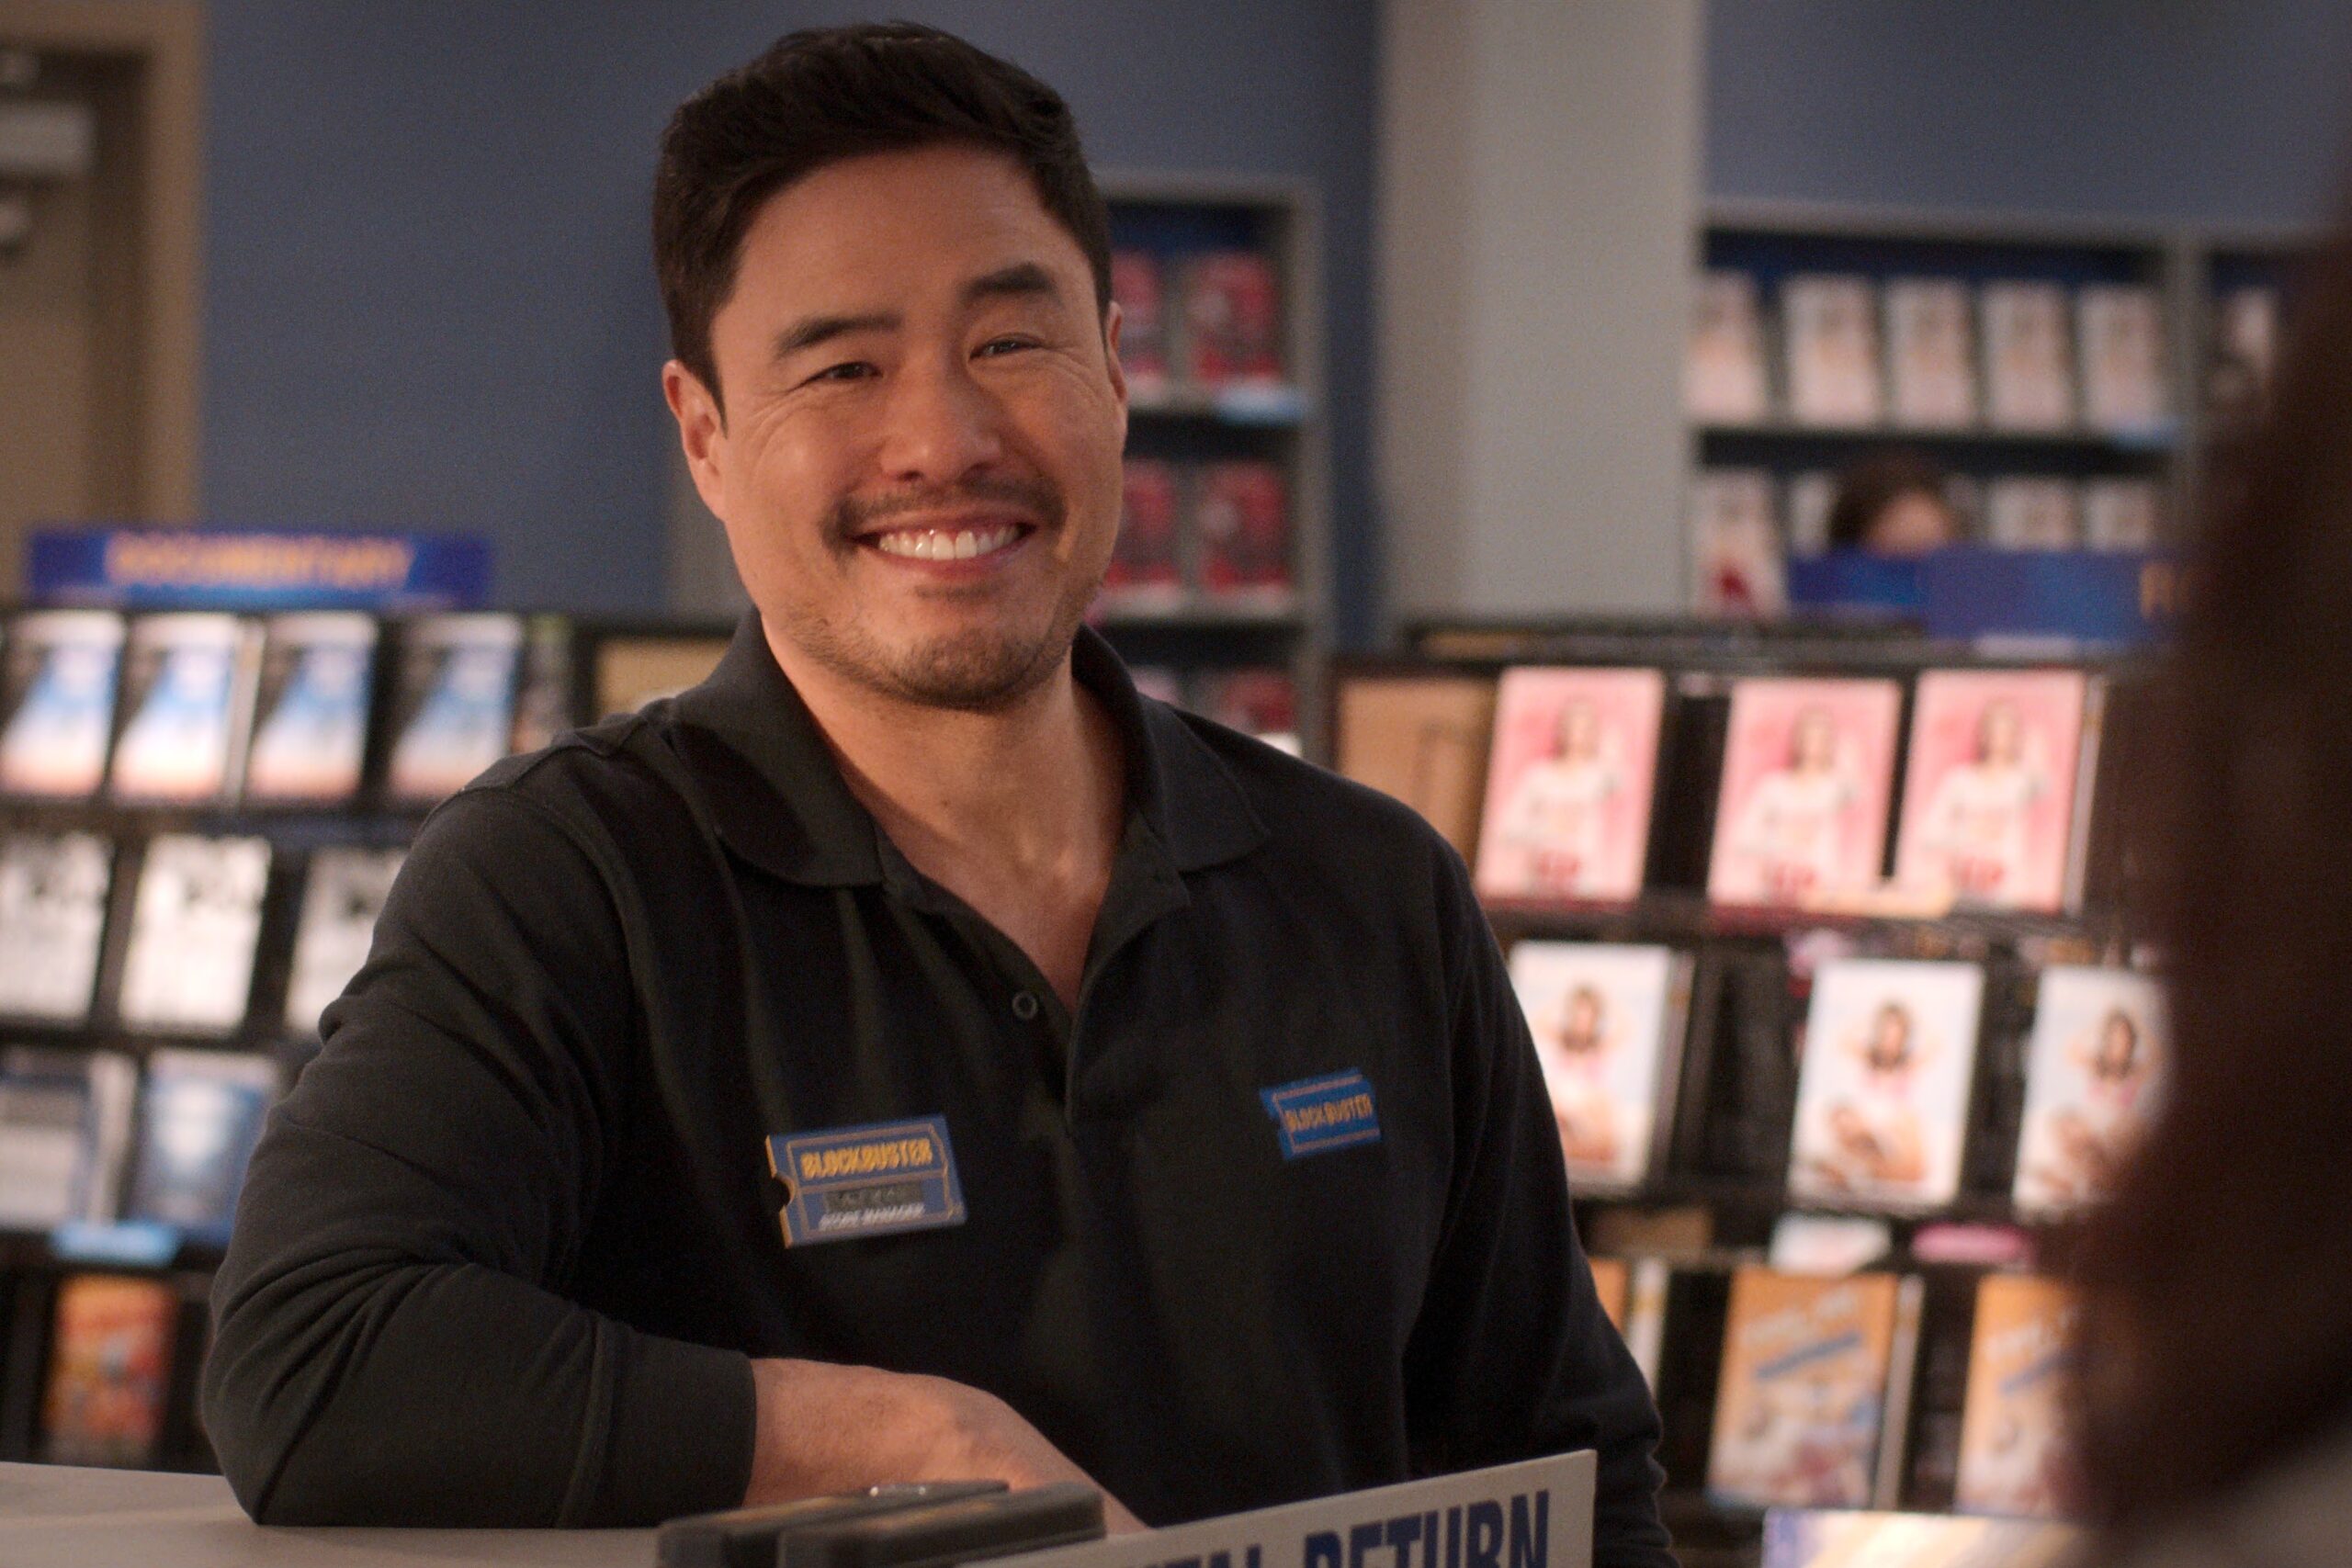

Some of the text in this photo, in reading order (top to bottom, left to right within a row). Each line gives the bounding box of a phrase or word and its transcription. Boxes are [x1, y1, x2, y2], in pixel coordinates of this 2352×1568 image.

[105, 532, 415, 586] DOCUMENTARY
[1284, 1092, 1374, 1133] BLOCKBUSTER
[799, 1137, 933, 1180] BLOCKBUSTER
